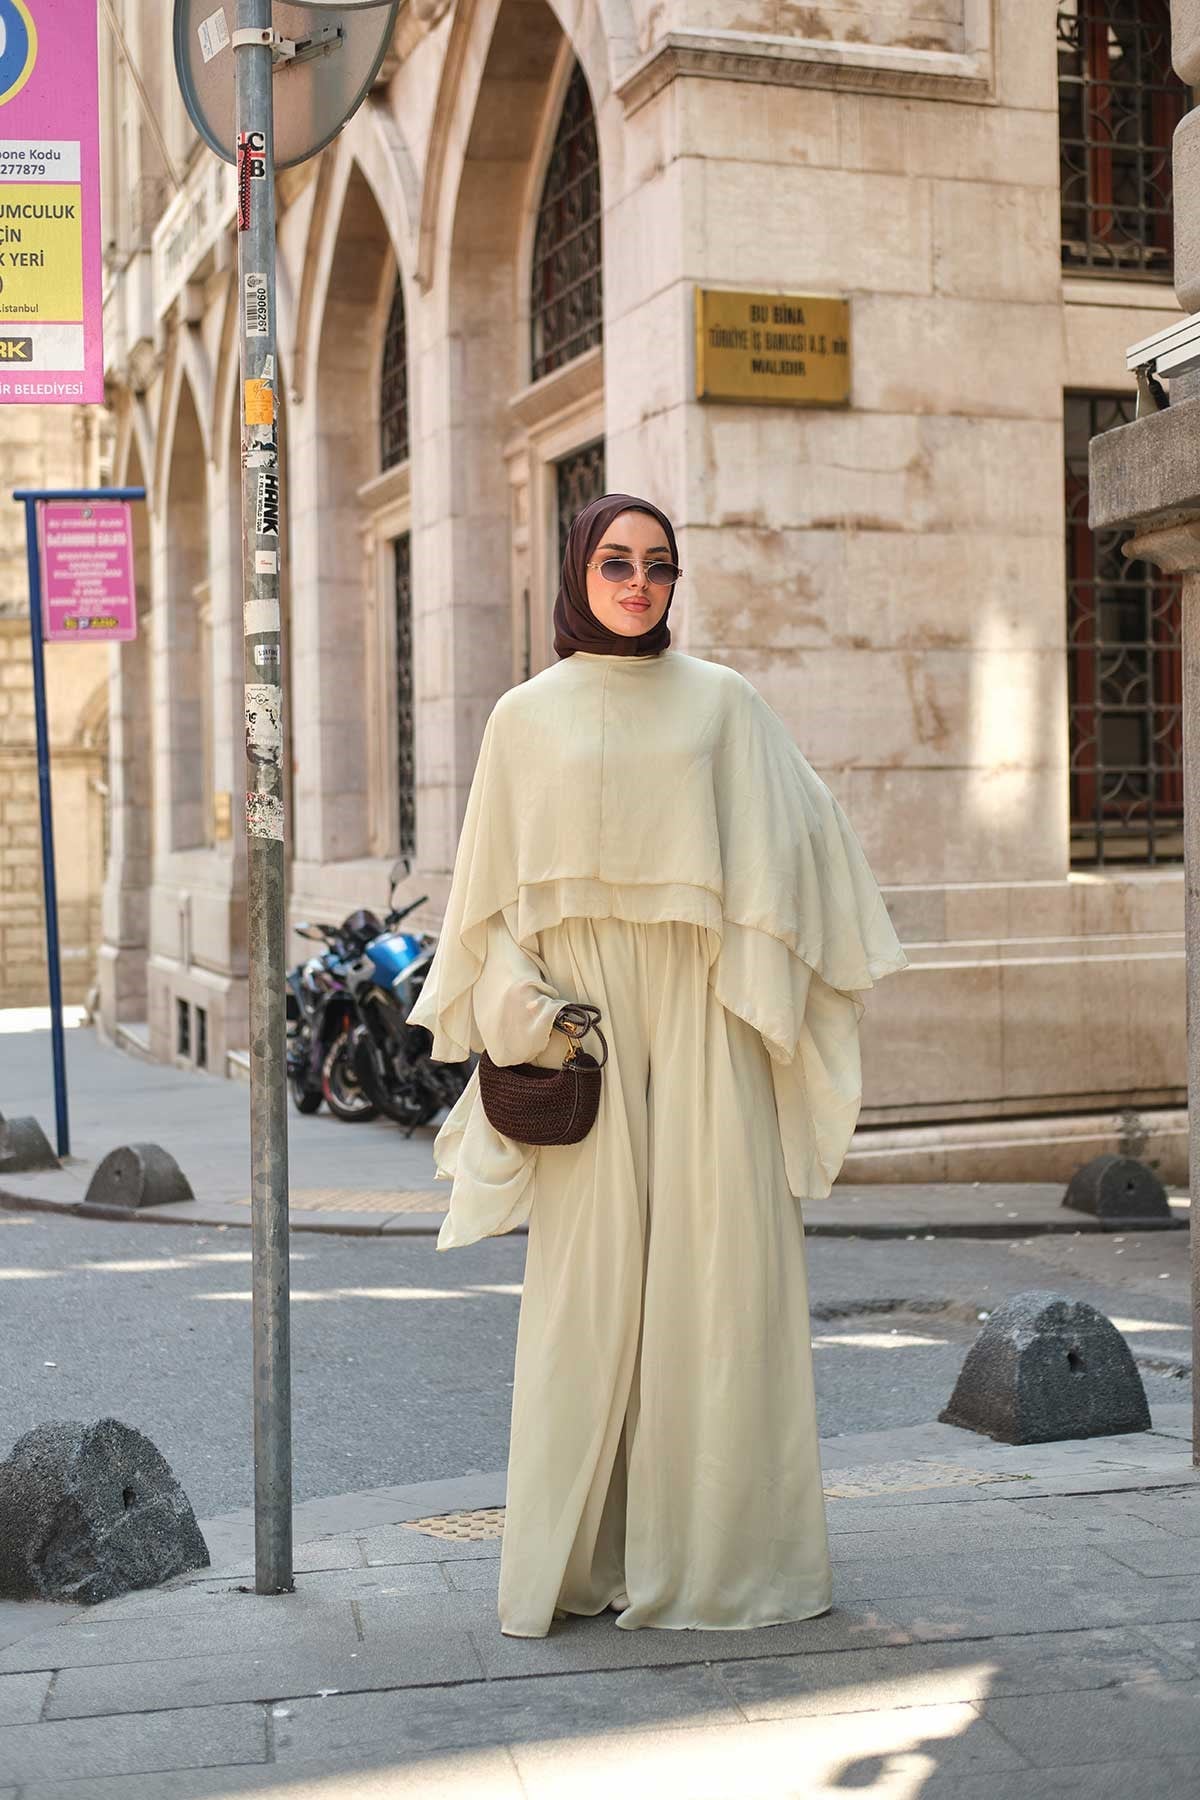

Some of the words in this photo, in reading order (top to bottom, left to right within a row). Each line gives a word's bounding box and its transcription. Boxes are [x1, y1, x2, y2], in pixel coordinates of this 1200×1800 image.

[0, 150, 26, 160] one
[29, 149, 61, 160] Kodu
[9, 249, 44, 267] YERİ
[257, 287, 267, 332] 0906261
[751, 304, 768, 324] BU
[773, 303, 806, 325] BİNA
[14, 381, 83, 395] BELEDİYESİ
[262, 474, 279, 536] HANK
